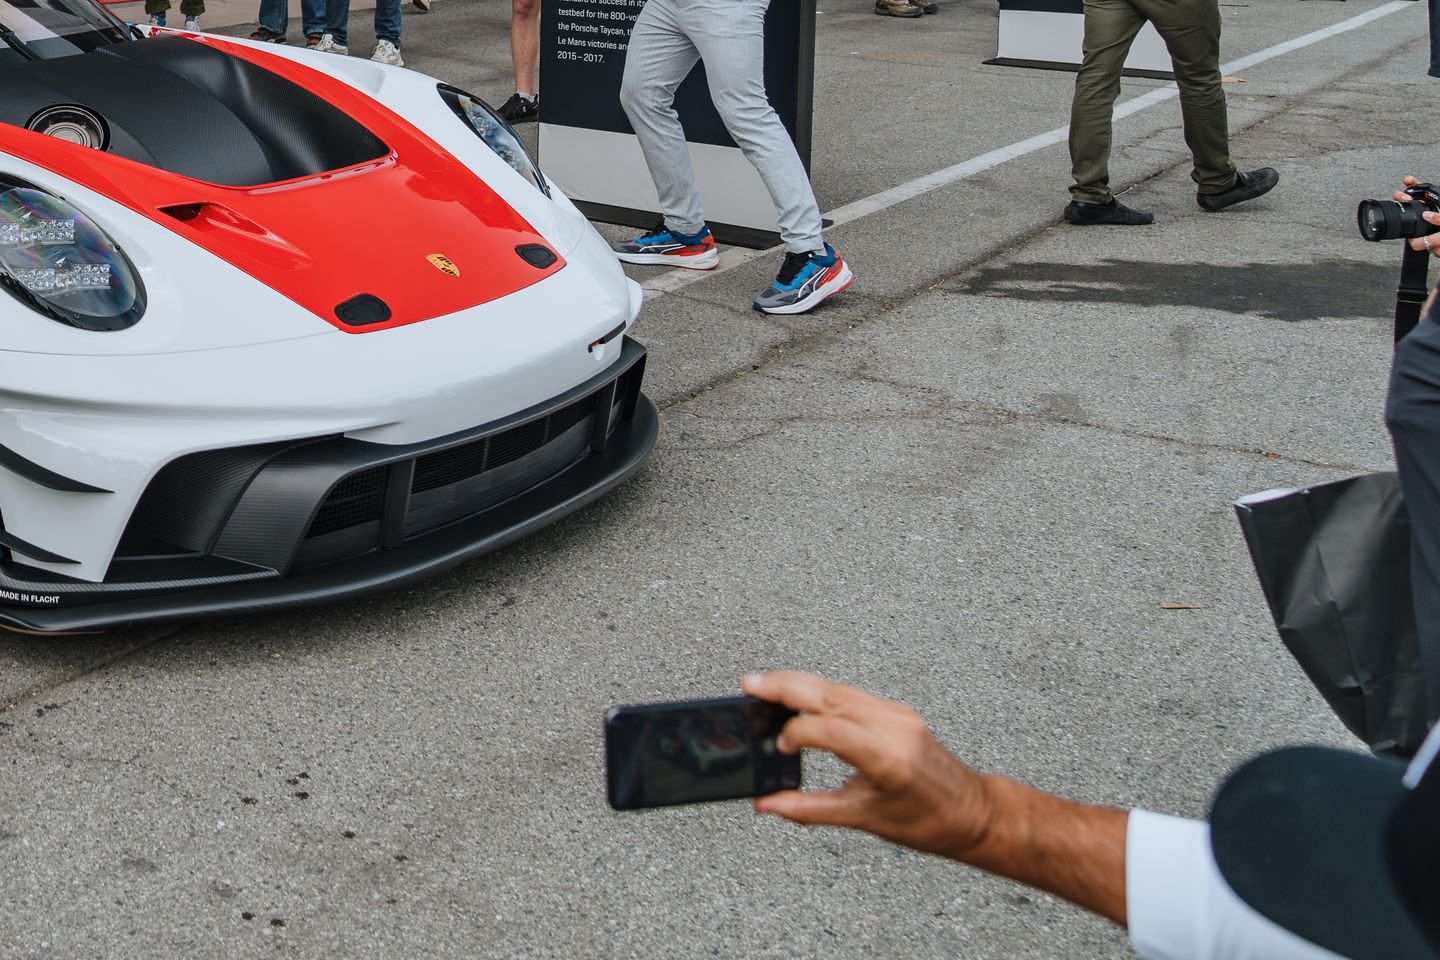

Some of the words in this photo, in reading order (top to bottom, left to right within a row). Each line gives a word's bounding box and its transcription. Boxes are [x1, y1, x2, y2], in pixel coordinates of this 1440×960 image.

[558, 8, 584, 17] testbed
[598, 11, 609, 19] the
[610, 12, 639, 21] 800-vo
[558, 22, 569, 30] the
[571, 23, 598, 33] Porsche
[600, 25, 625, 36] Taycan,
[558, 36, 566, 45] Le
[568, 37, 586, 46] Mans
[588, 39, 617, 50] victories
[0, 590, 19, 600] MADE
[21, 594, 29, 602] IN
[31, 594, 59, 603] FLACHT
